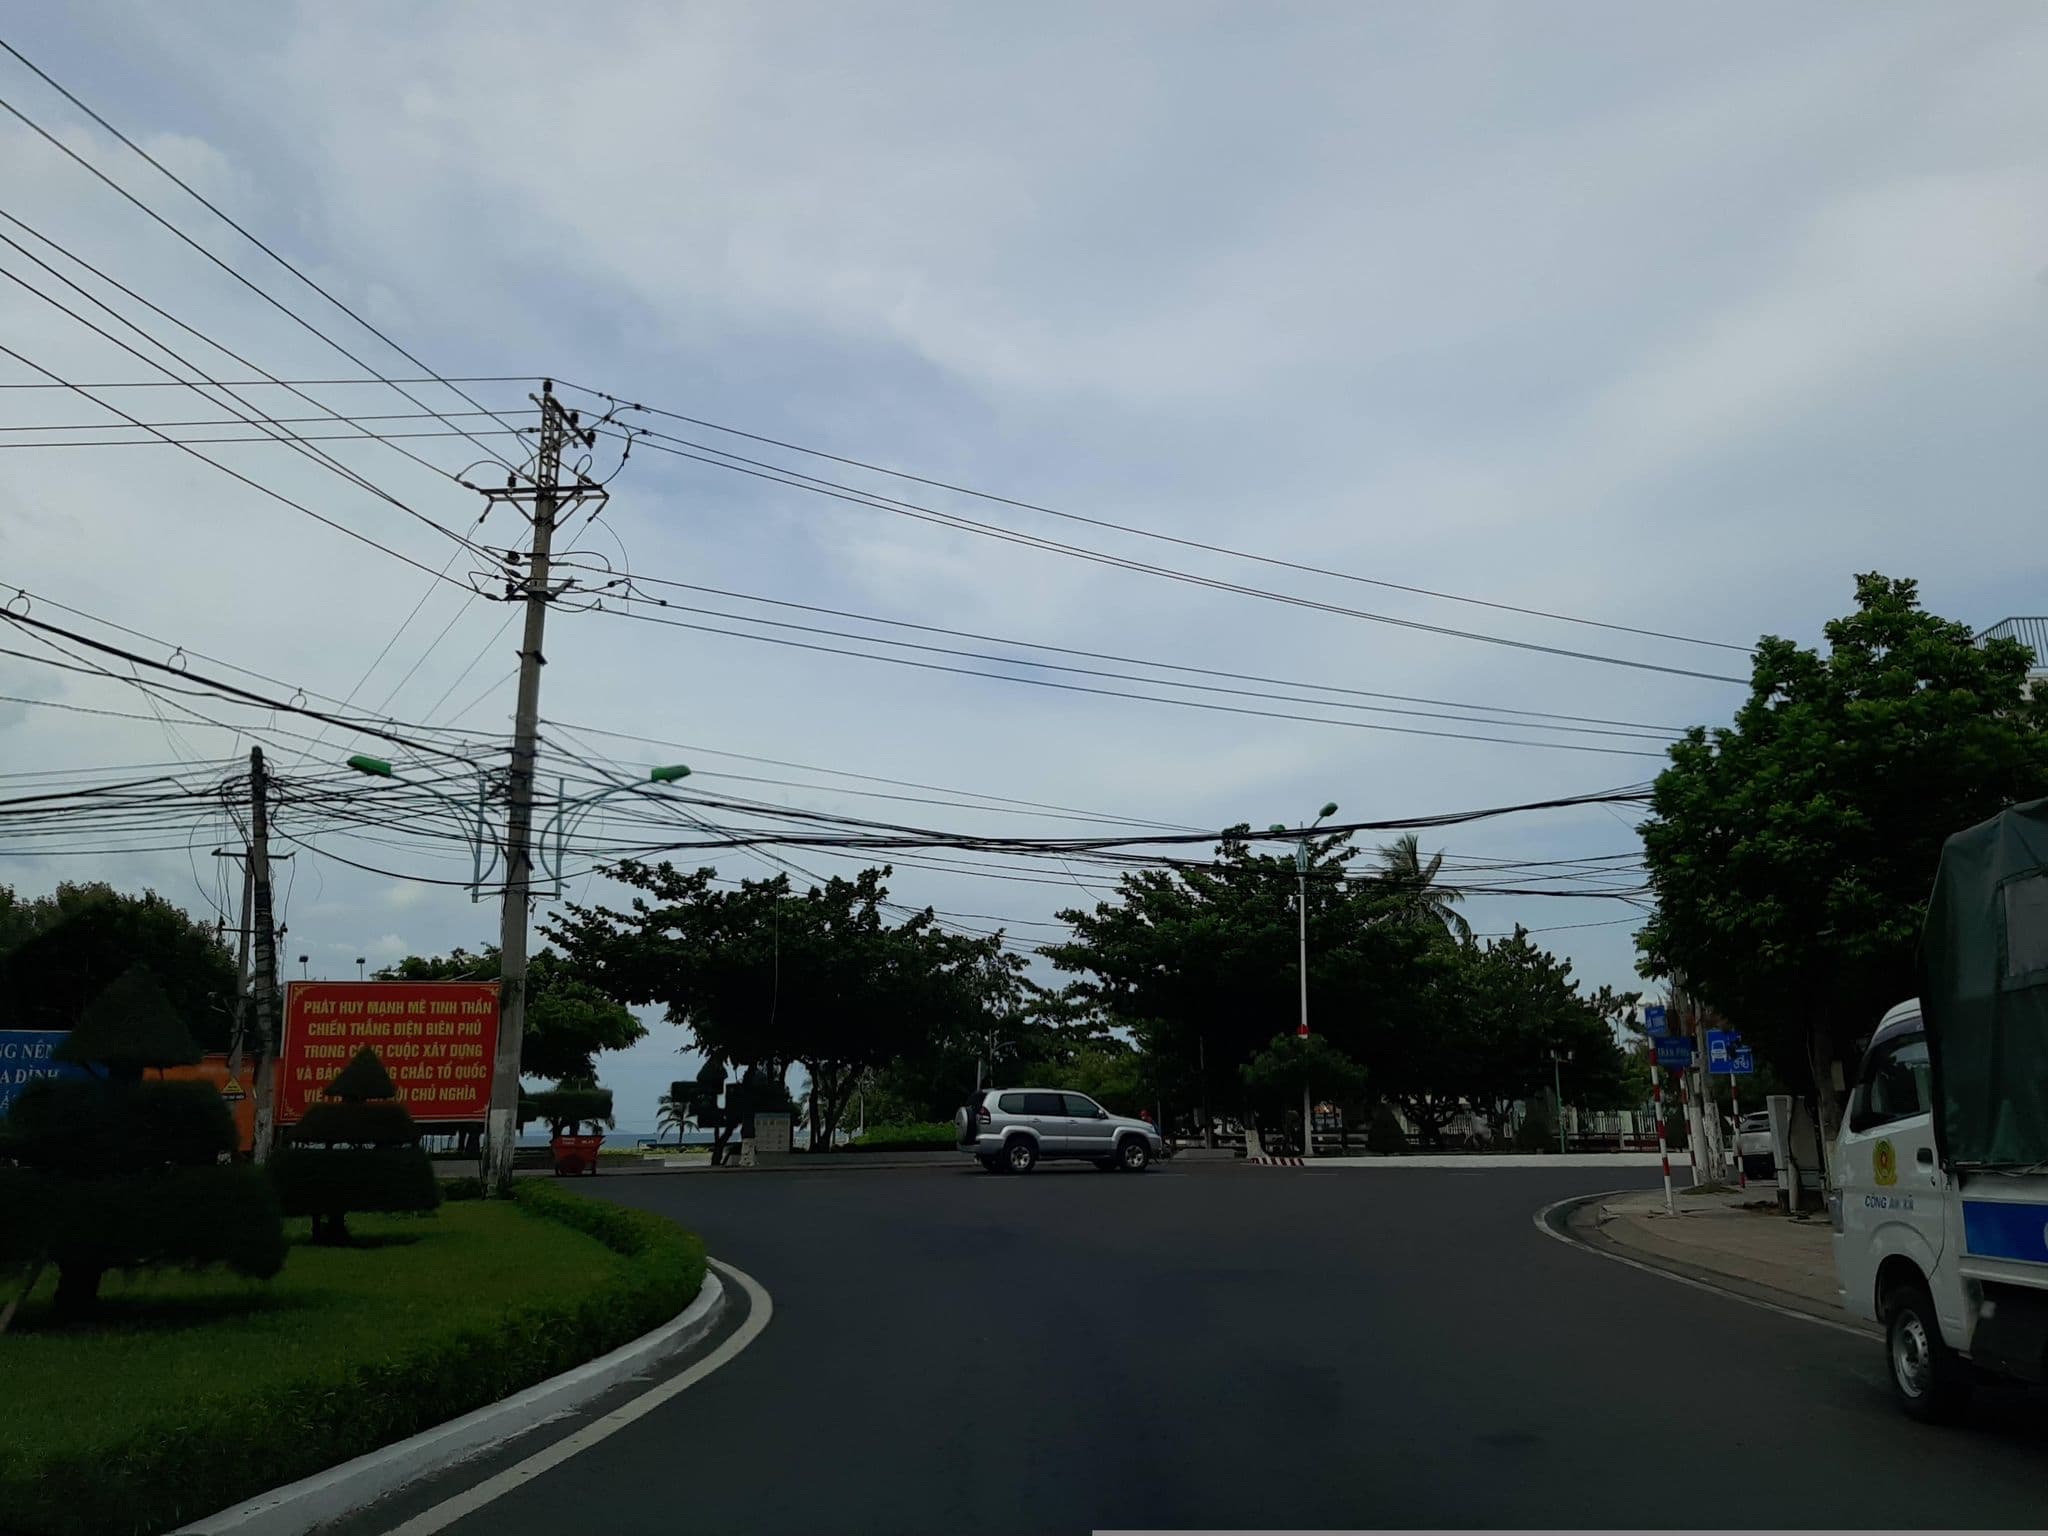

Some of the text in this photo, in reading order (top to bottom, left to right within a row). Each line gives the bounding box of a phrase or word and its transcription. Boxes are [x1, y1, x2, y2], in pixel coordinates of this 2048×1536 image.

[303, 998, 337, 1014] PHÁT
[339, 1000, 364, 1014] HUY
[367, 1000, 404, 1016] MẠNH
[430, 1001, 458, 1014] TINH
[308, 1018, 347, 1036] CHIẾN
[350, 1018, 390, 1036] THẮNG
[426, 1019, 455, 1036] BIÊN
[304, 1044, 345, 1058] TRONG
[386, 1041, 420, 1060] CUỘC
[423, 1041, 447, 1057] XÂY
[295, 1064, 313, 1081] VÀ
[400, 1061, 434, 1080] CHẮC
[455, 1061, 488, 1080] QUỐC
[411, 1084, 436, 1101] CHỦ
[1864, 1193, 1887, 1209] CÔNG
